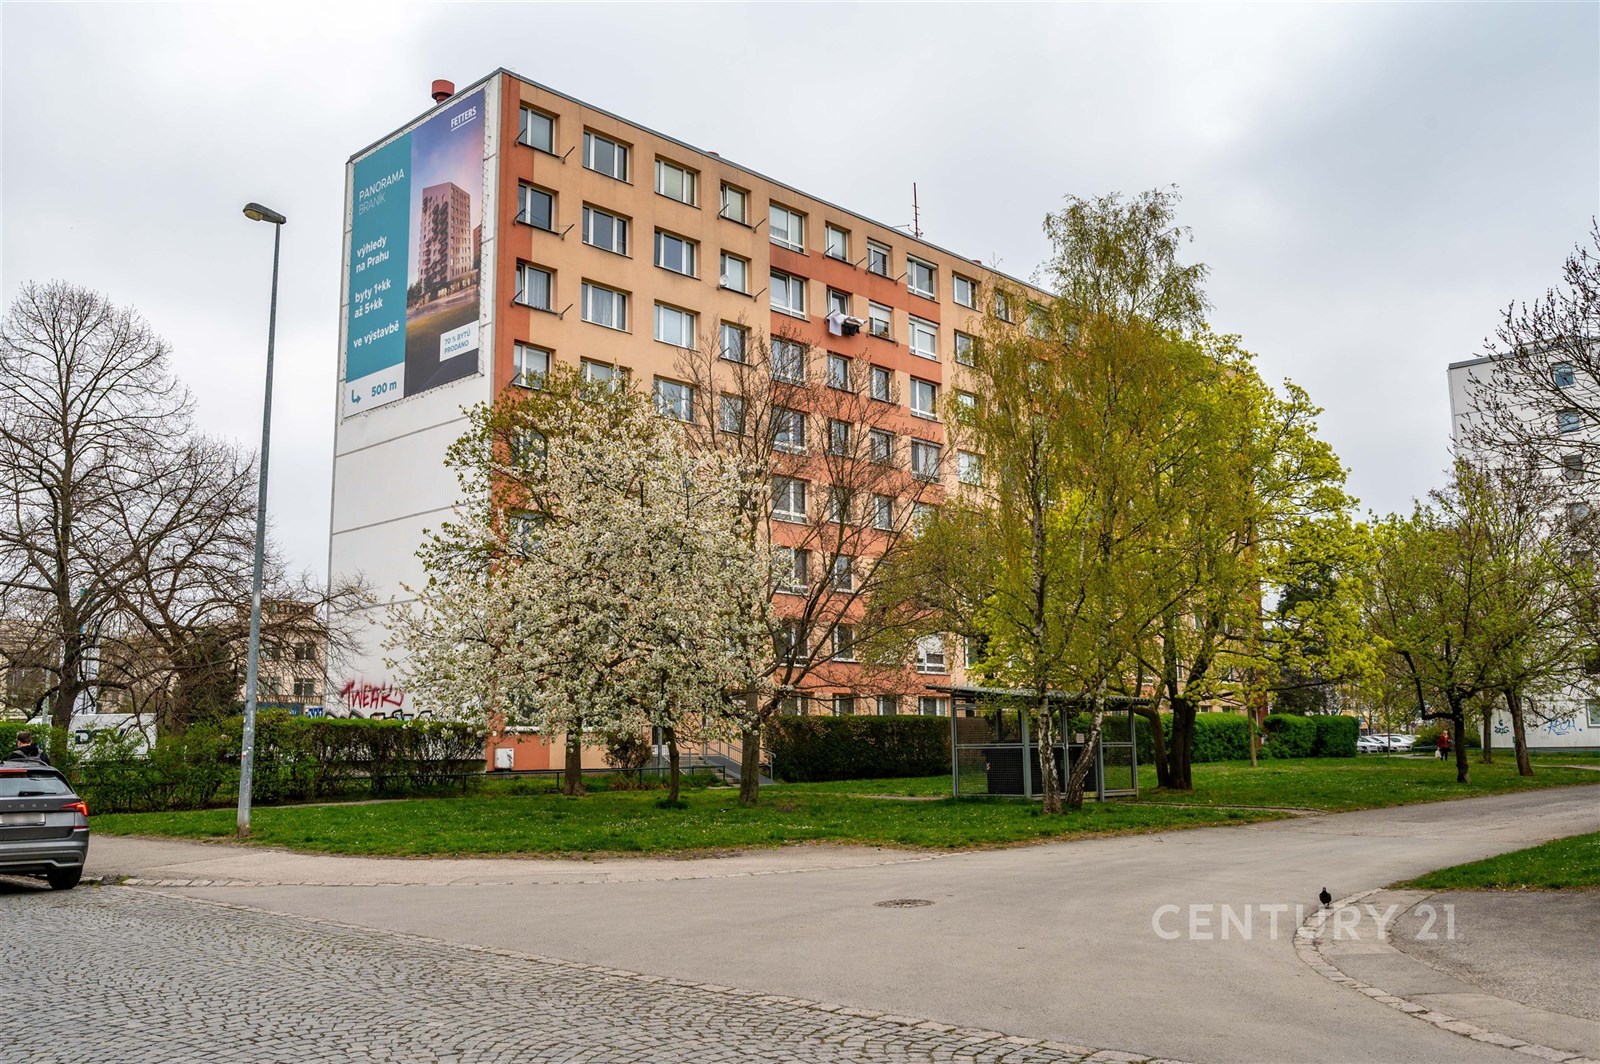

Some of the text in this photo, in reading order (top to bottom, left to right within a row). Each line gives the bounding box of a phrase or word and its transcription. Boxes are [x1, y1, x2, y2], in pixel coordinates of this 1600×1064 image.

[450, 106, 477, 128] FETTERS
[359, 169, 405, 201] PANORAMA
[356, 235, 387, 258] výhledy
[355, 250, 390, 273] na Prahu
[355, 278, 392, 304] byty 1+kk
[354, 297, 383, 319] až 5+kk
[353, 320, 400, 348] ve výstavbě
[371, 381, 397, 398] 500 m
